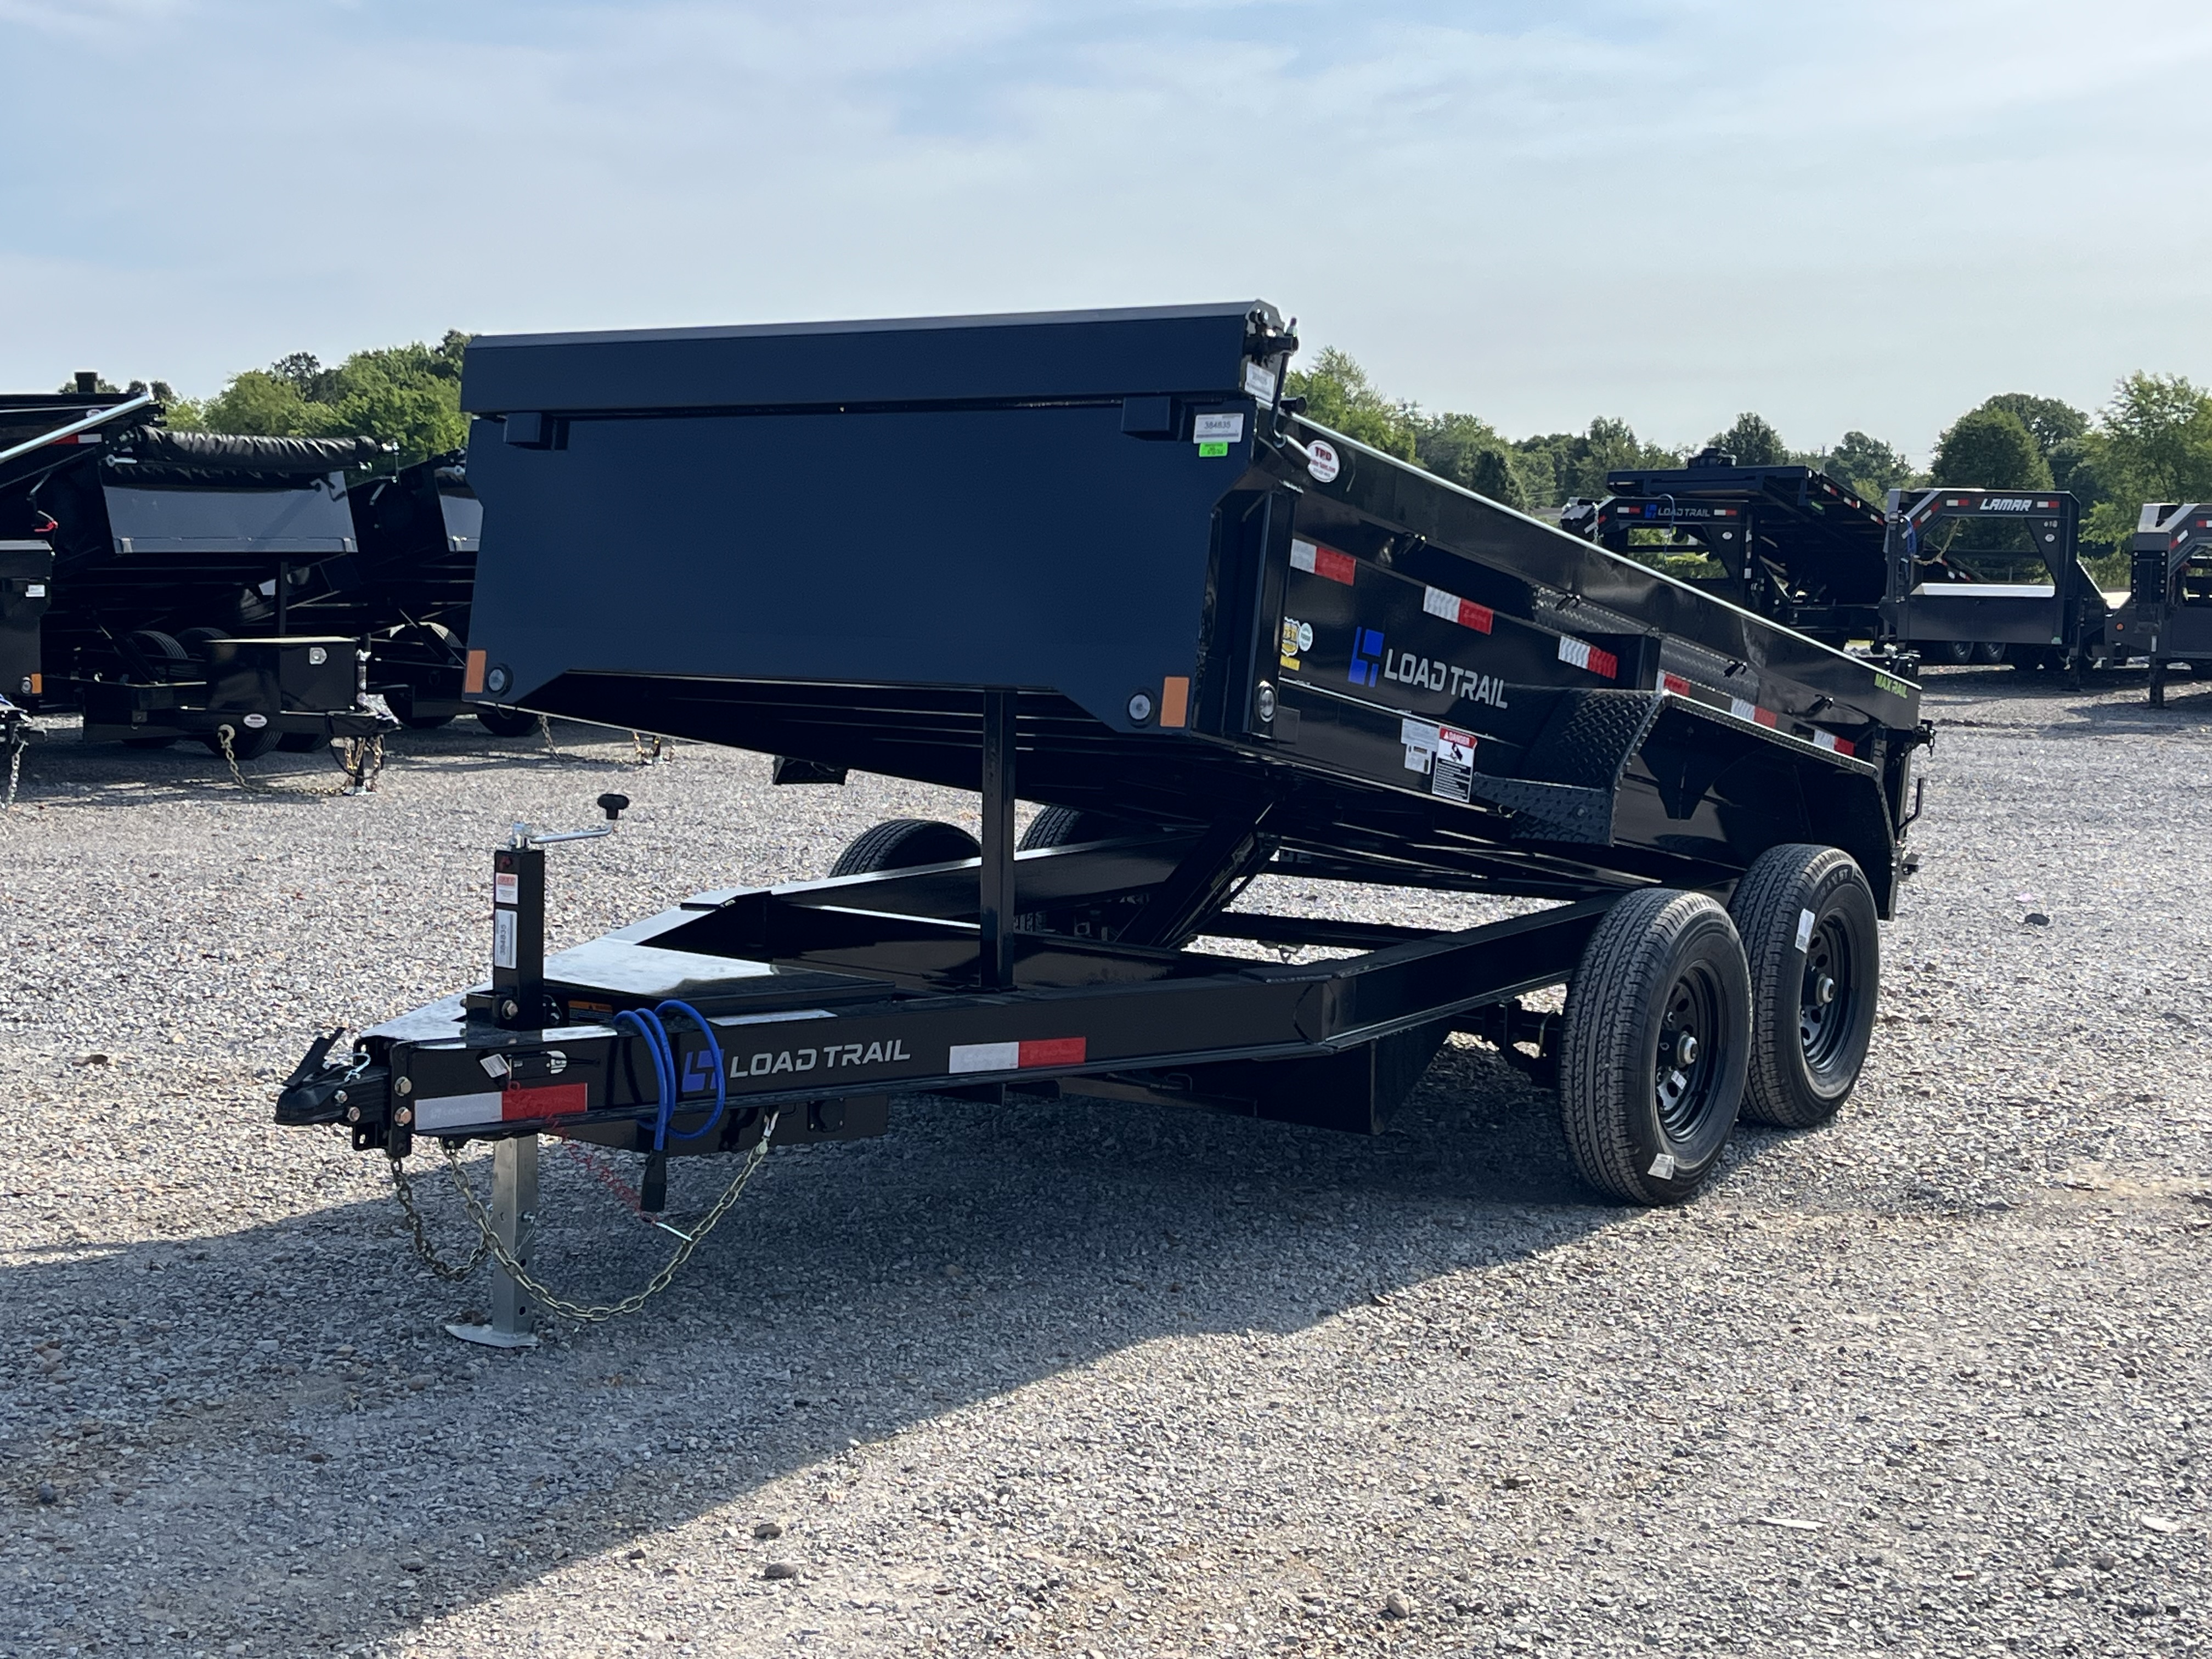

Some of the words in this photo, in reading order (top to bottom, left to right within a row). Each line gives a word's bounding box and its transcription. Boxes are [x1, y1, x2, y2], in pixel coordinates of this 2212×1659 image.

[1658, 507, 1684, 517] LOAD
[1685, 508, 1711, 517] TRAIL
[1979, 498, 2032, 511] LAMAR
[1384, 648, 1447, 692] LOAD
[1450, 665, 1508, 709] TRAIL
[1874, 673, 1892, 692] MAX
[729, 1048, 817, 1079] LOAD
[823, 1039, 911, 1068] TRAIL
